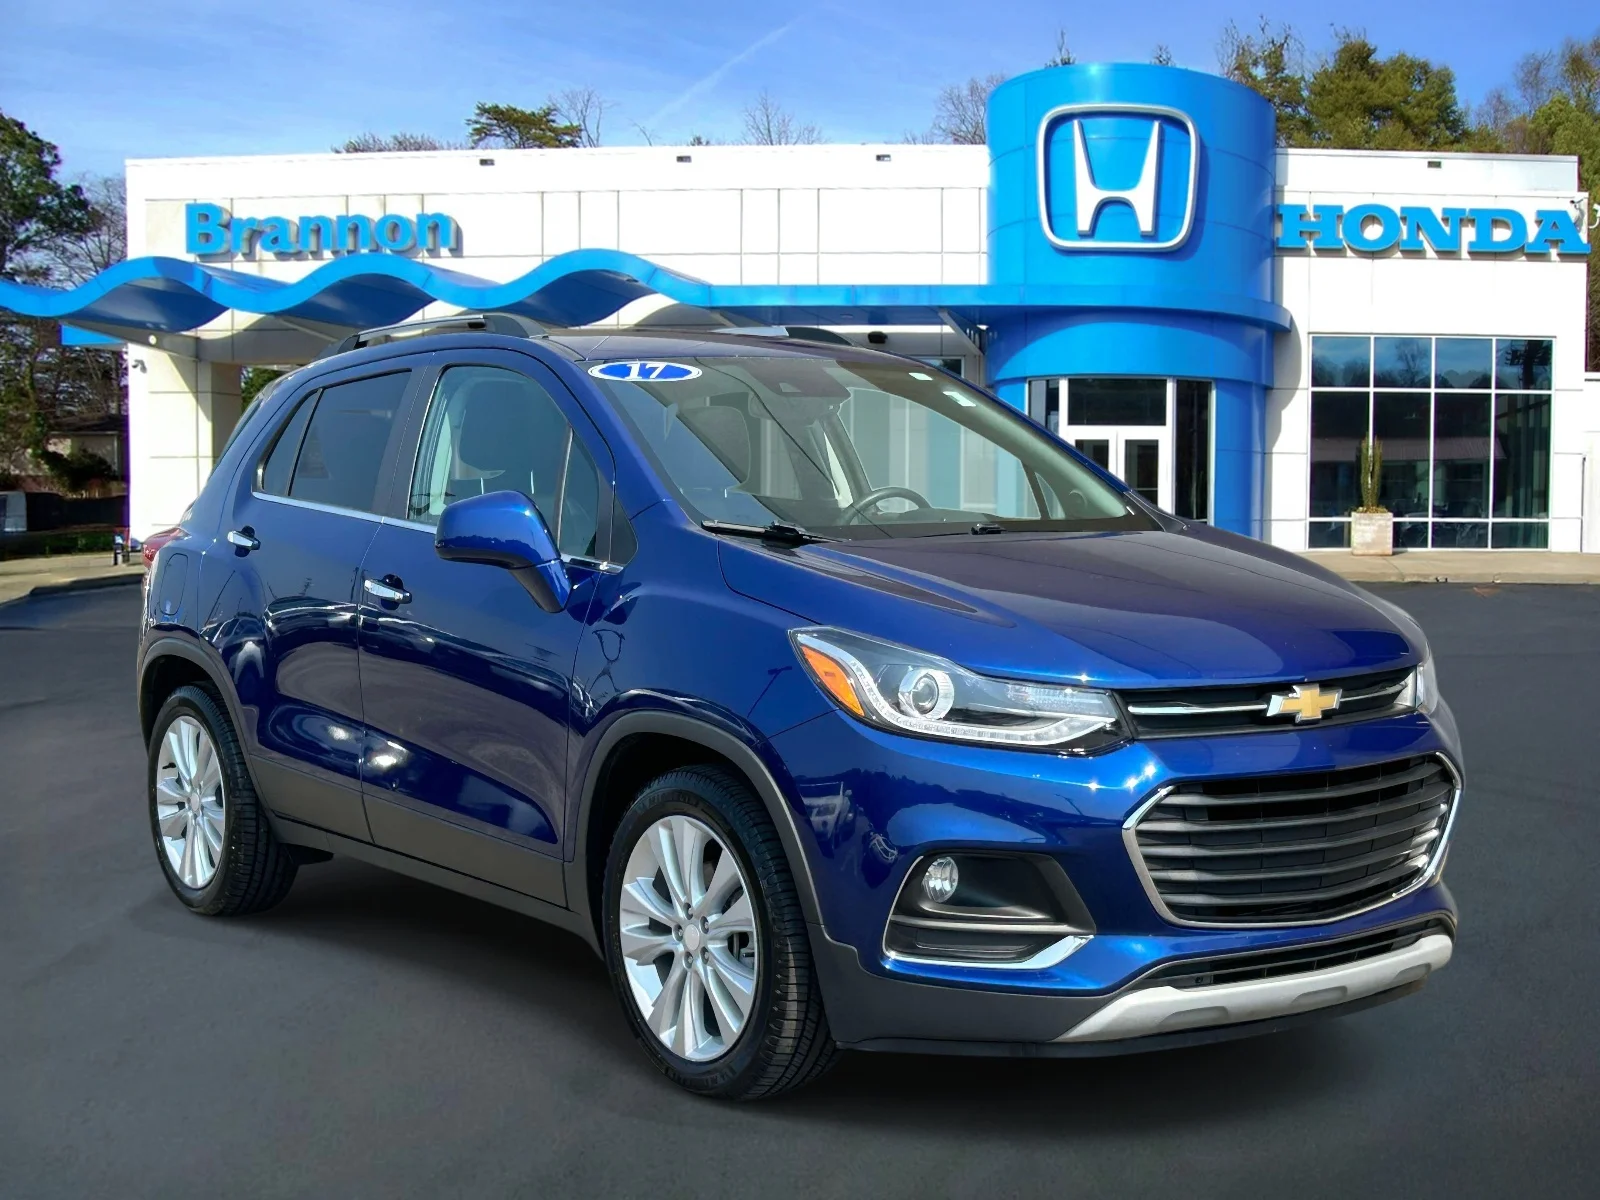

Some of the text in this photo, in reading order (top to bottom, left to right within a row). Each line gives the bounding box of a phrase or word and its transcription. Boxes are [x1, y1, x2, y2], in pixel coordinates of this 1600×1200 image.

[185, 202, 459, 255] Brannon
[1276, 203, 1591, 255] HONDA
[625, 361, 668, 380] 17
